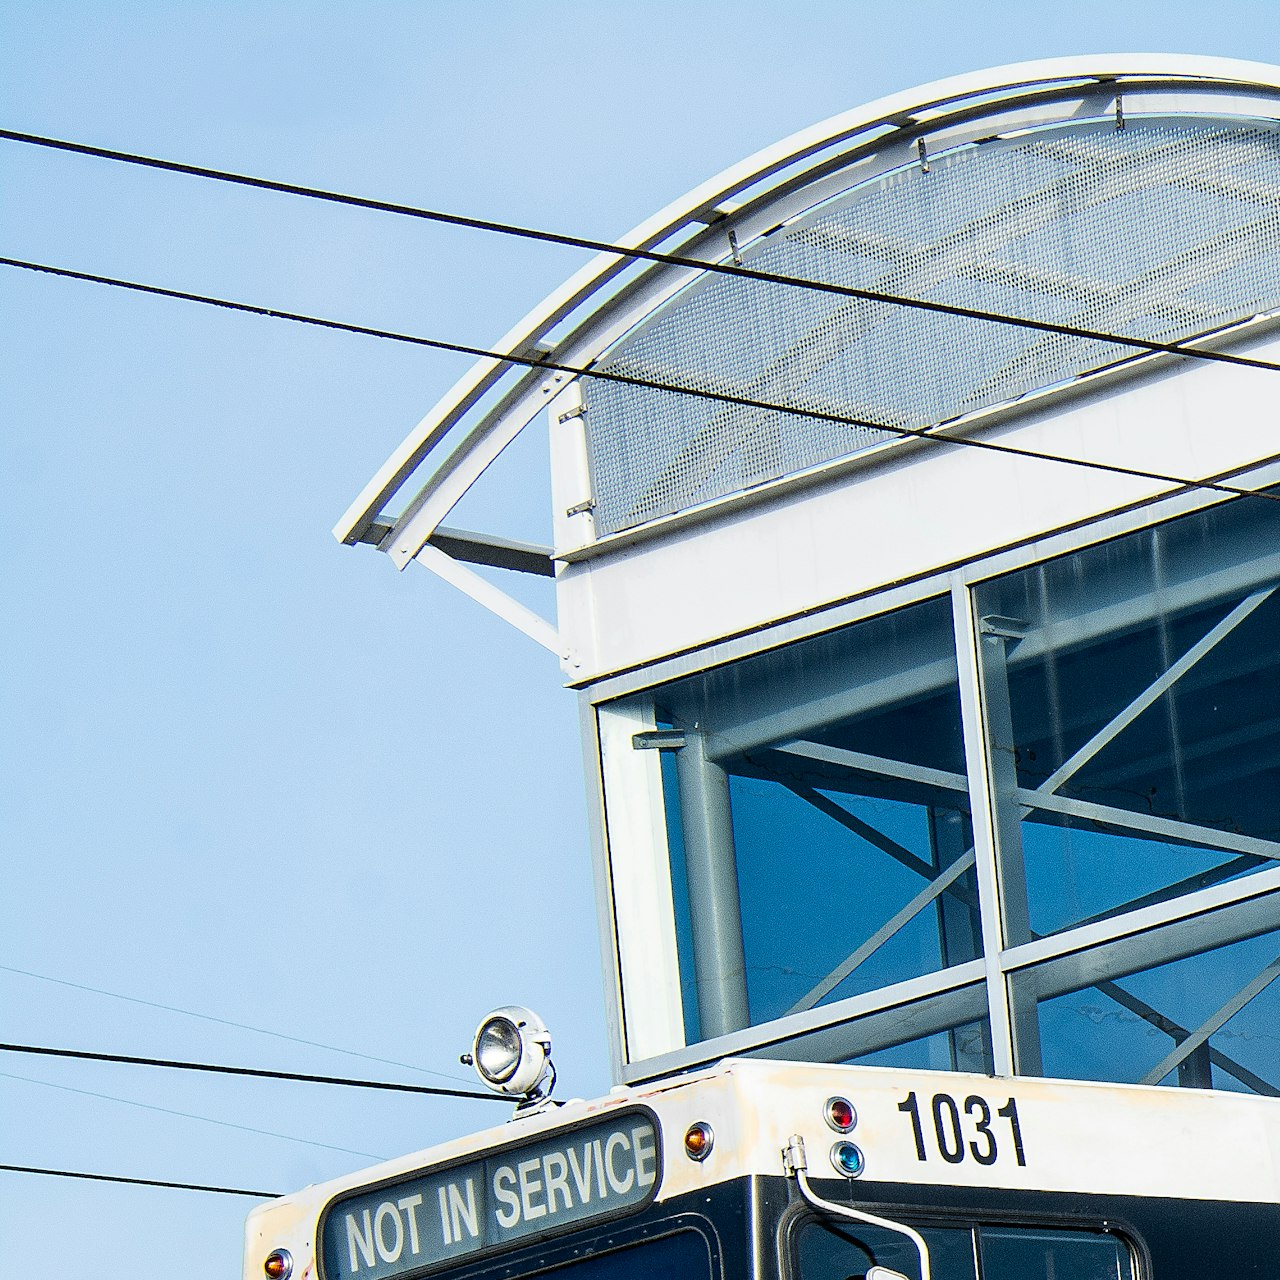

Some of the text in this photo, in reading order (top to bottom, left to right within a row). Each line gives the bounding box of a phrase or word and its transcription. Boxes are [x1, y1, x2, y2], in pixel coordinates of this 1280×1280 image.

[897, 1091, 1026, 1167] 1031
[346, 1125, 656, 1273] NOT IN SERVICE
